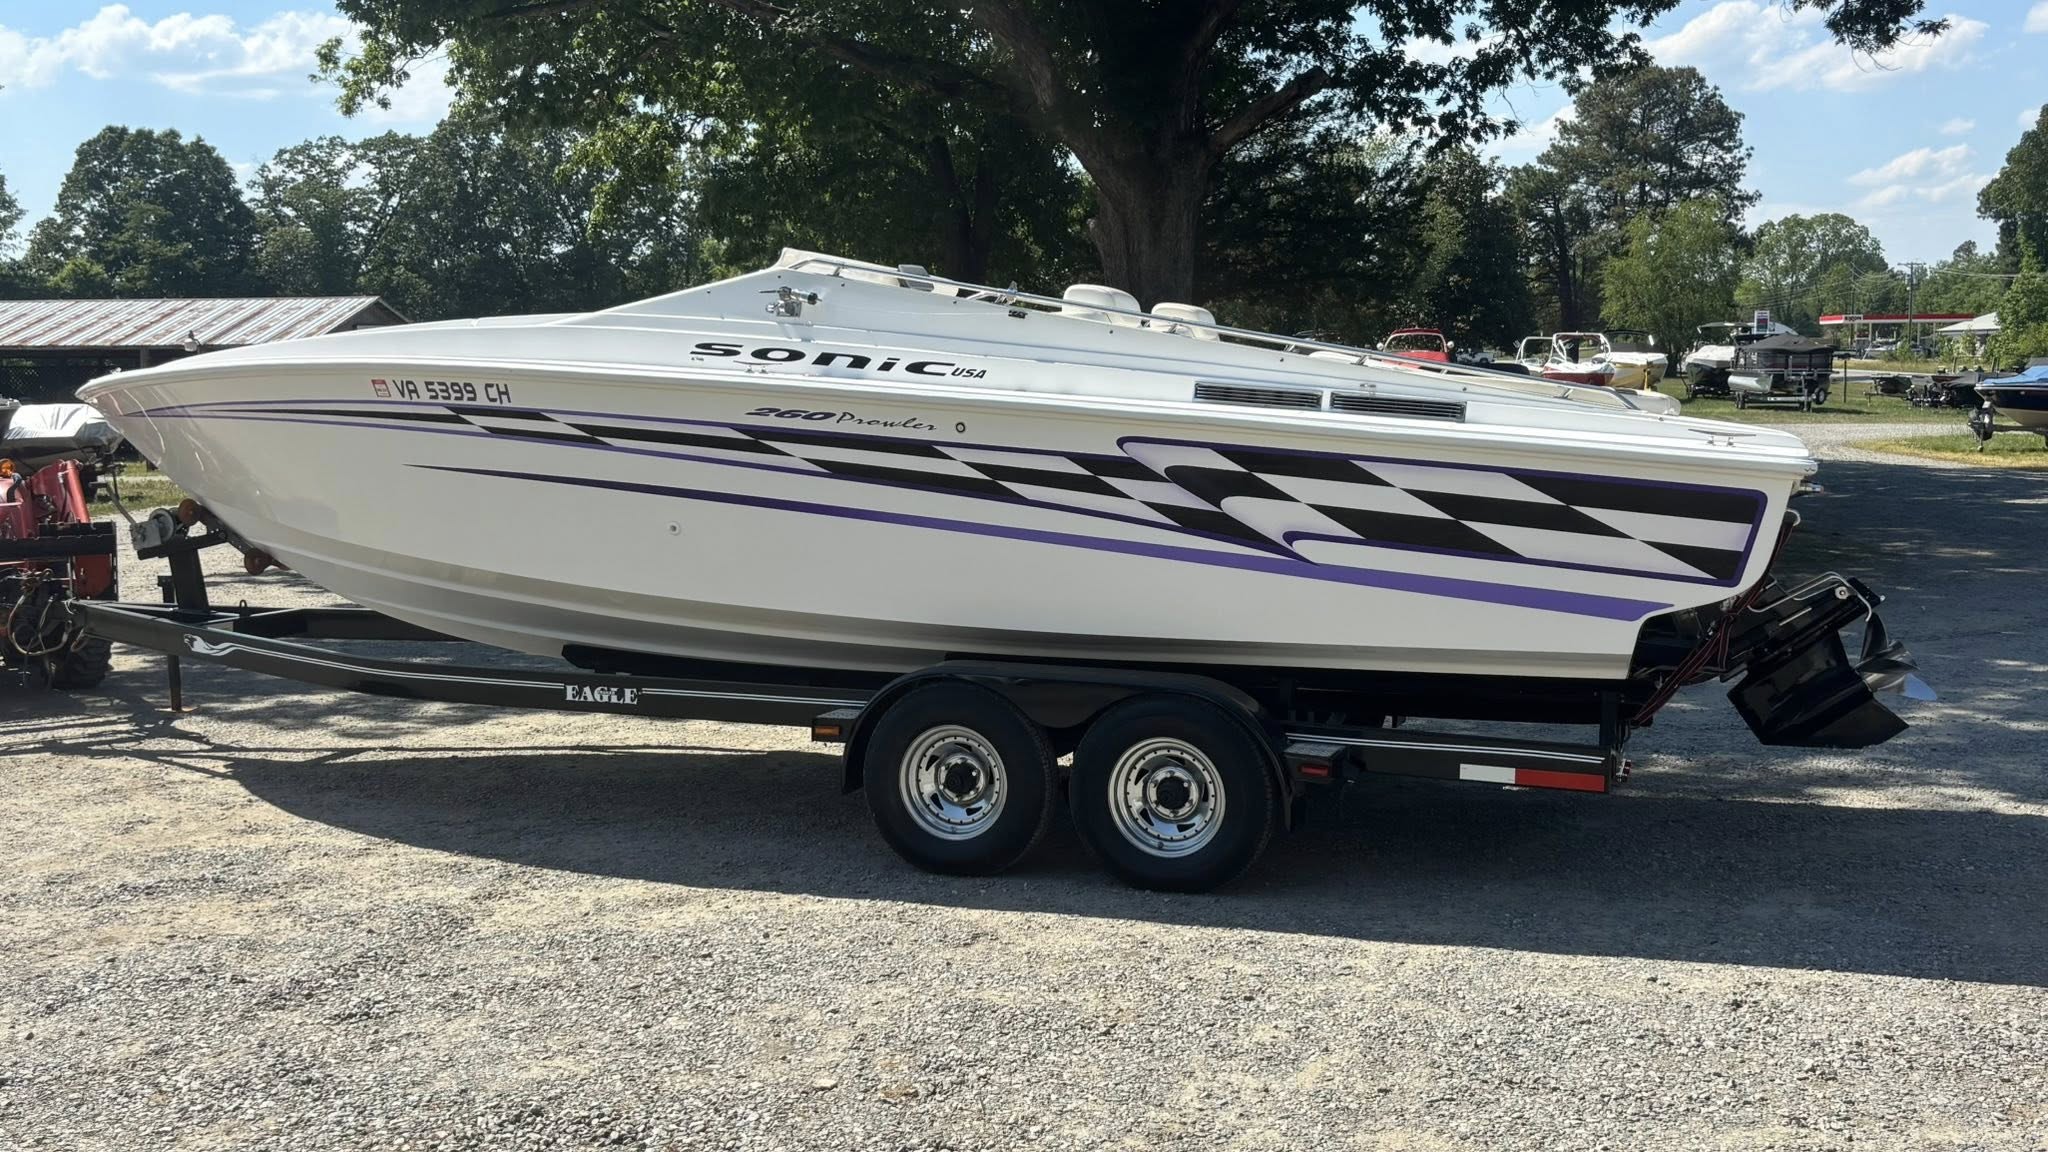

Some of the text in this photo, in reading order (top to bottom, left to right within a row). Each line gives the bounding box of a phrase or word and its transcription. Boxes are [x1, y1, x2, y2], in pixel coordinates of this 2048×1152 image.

[951, 367, 987, 379] USA
[392, 379, 420, 400] VA
[424, 381, 477, 401] 5399
[484, 383, 511, 404] CH
[745, 407, 937, 431] 260 Prowler
[565, 684, 638, 705] EAGLE
